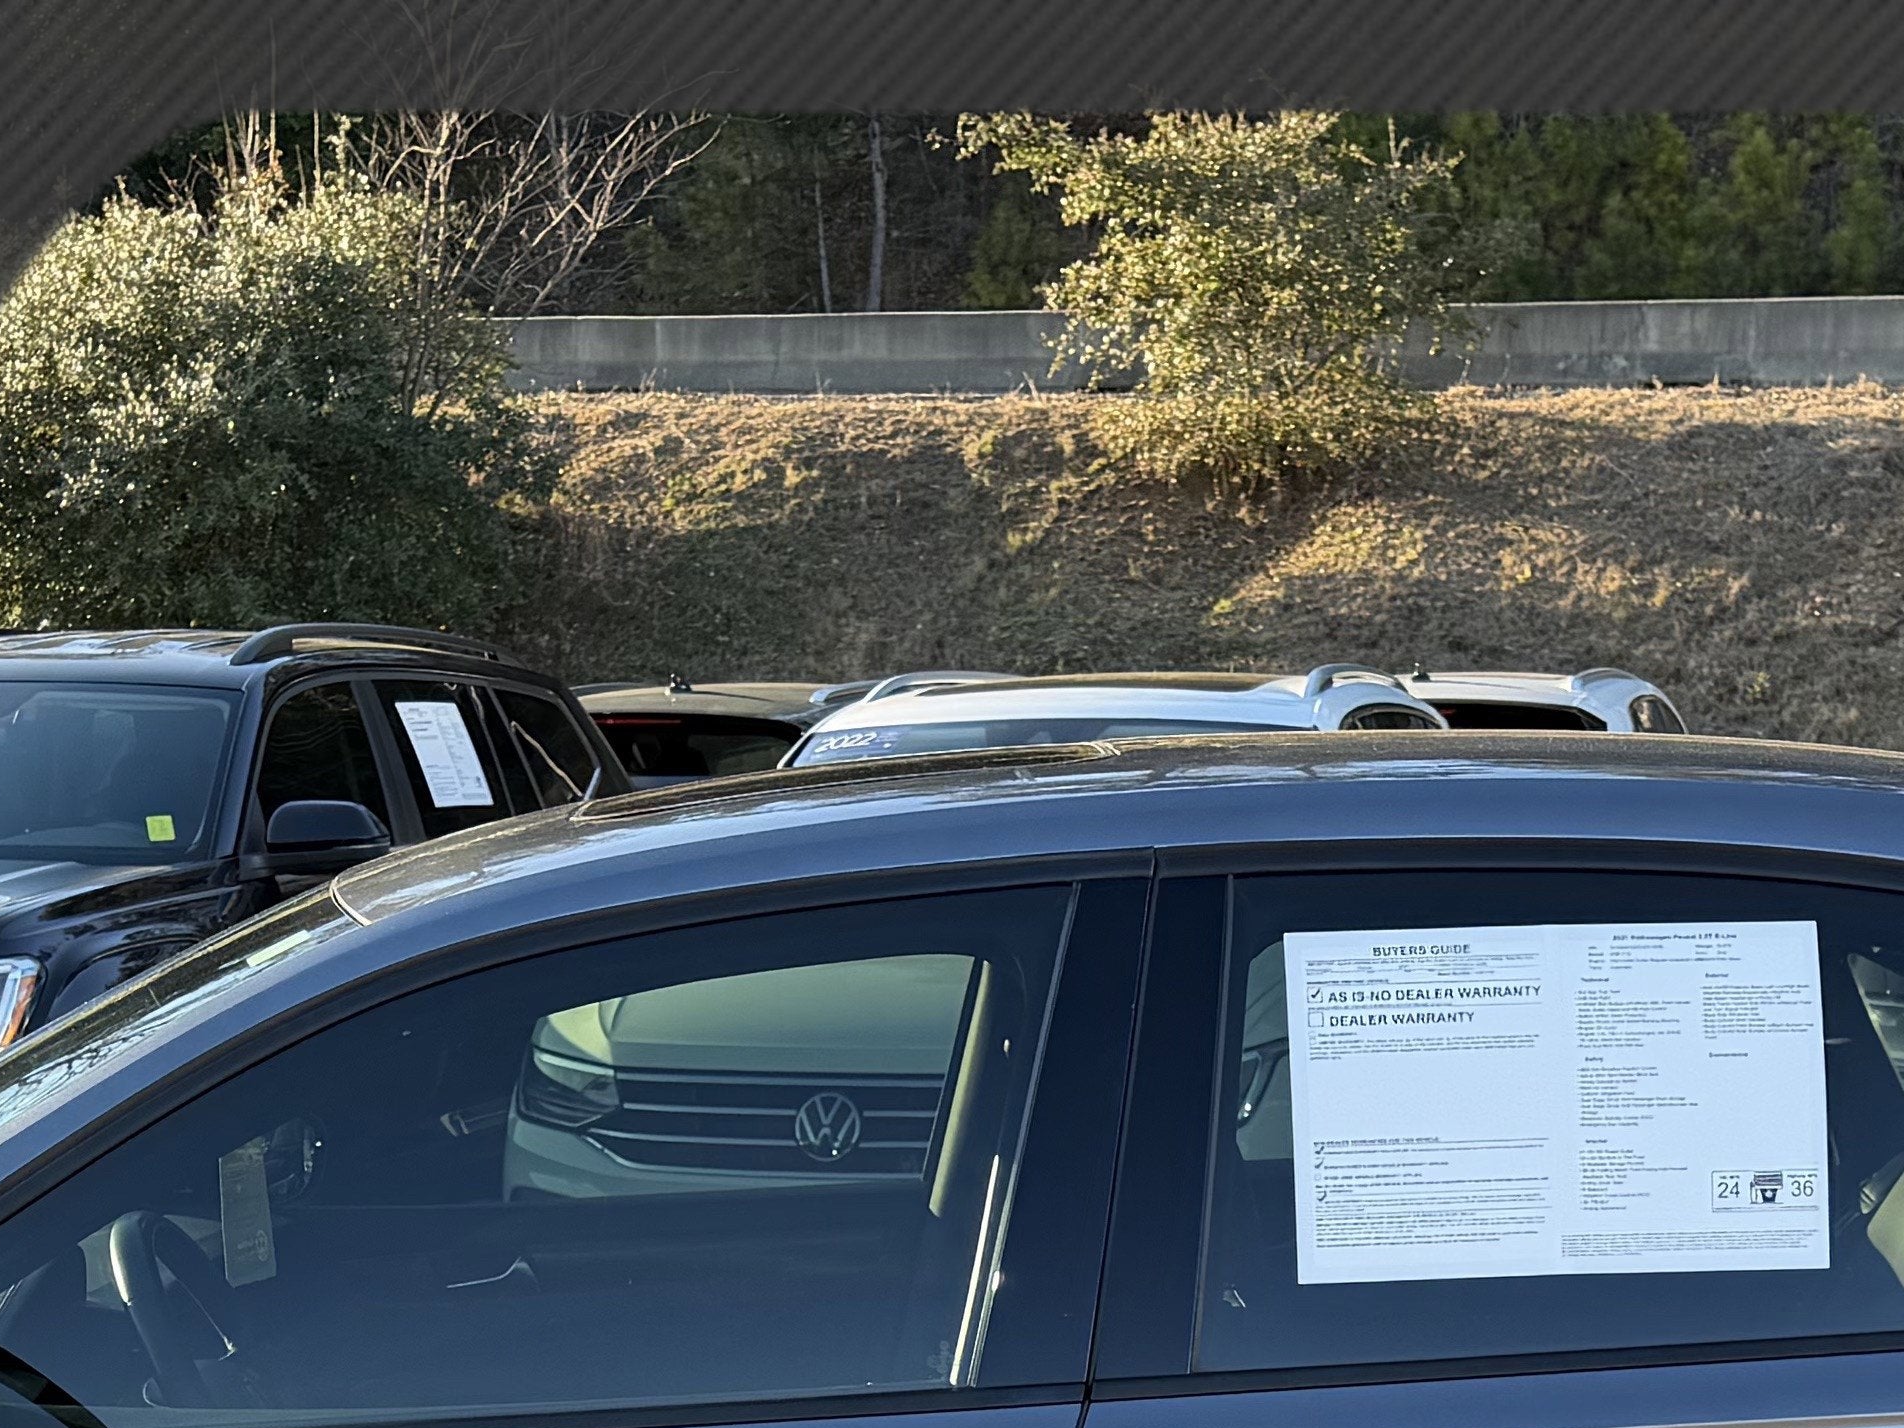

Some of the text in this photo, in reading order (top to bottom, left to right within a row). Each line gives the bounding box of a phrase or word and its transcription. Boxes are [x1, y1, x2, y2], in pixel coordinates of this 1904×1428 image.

[814, 731, 877, 753] 2022
[1430, 944, 1472, 955] GUIDE
[1328, 990, 1347, 1003] AS
[1395, 986, 1454, 1001] DEALER
[1458, 984, 1541, 999] WARRANTY
[1330, 1011, 1475, 1027] DEALER WARRANTY
[1717, 1180, 1814, 1199] 24 36
